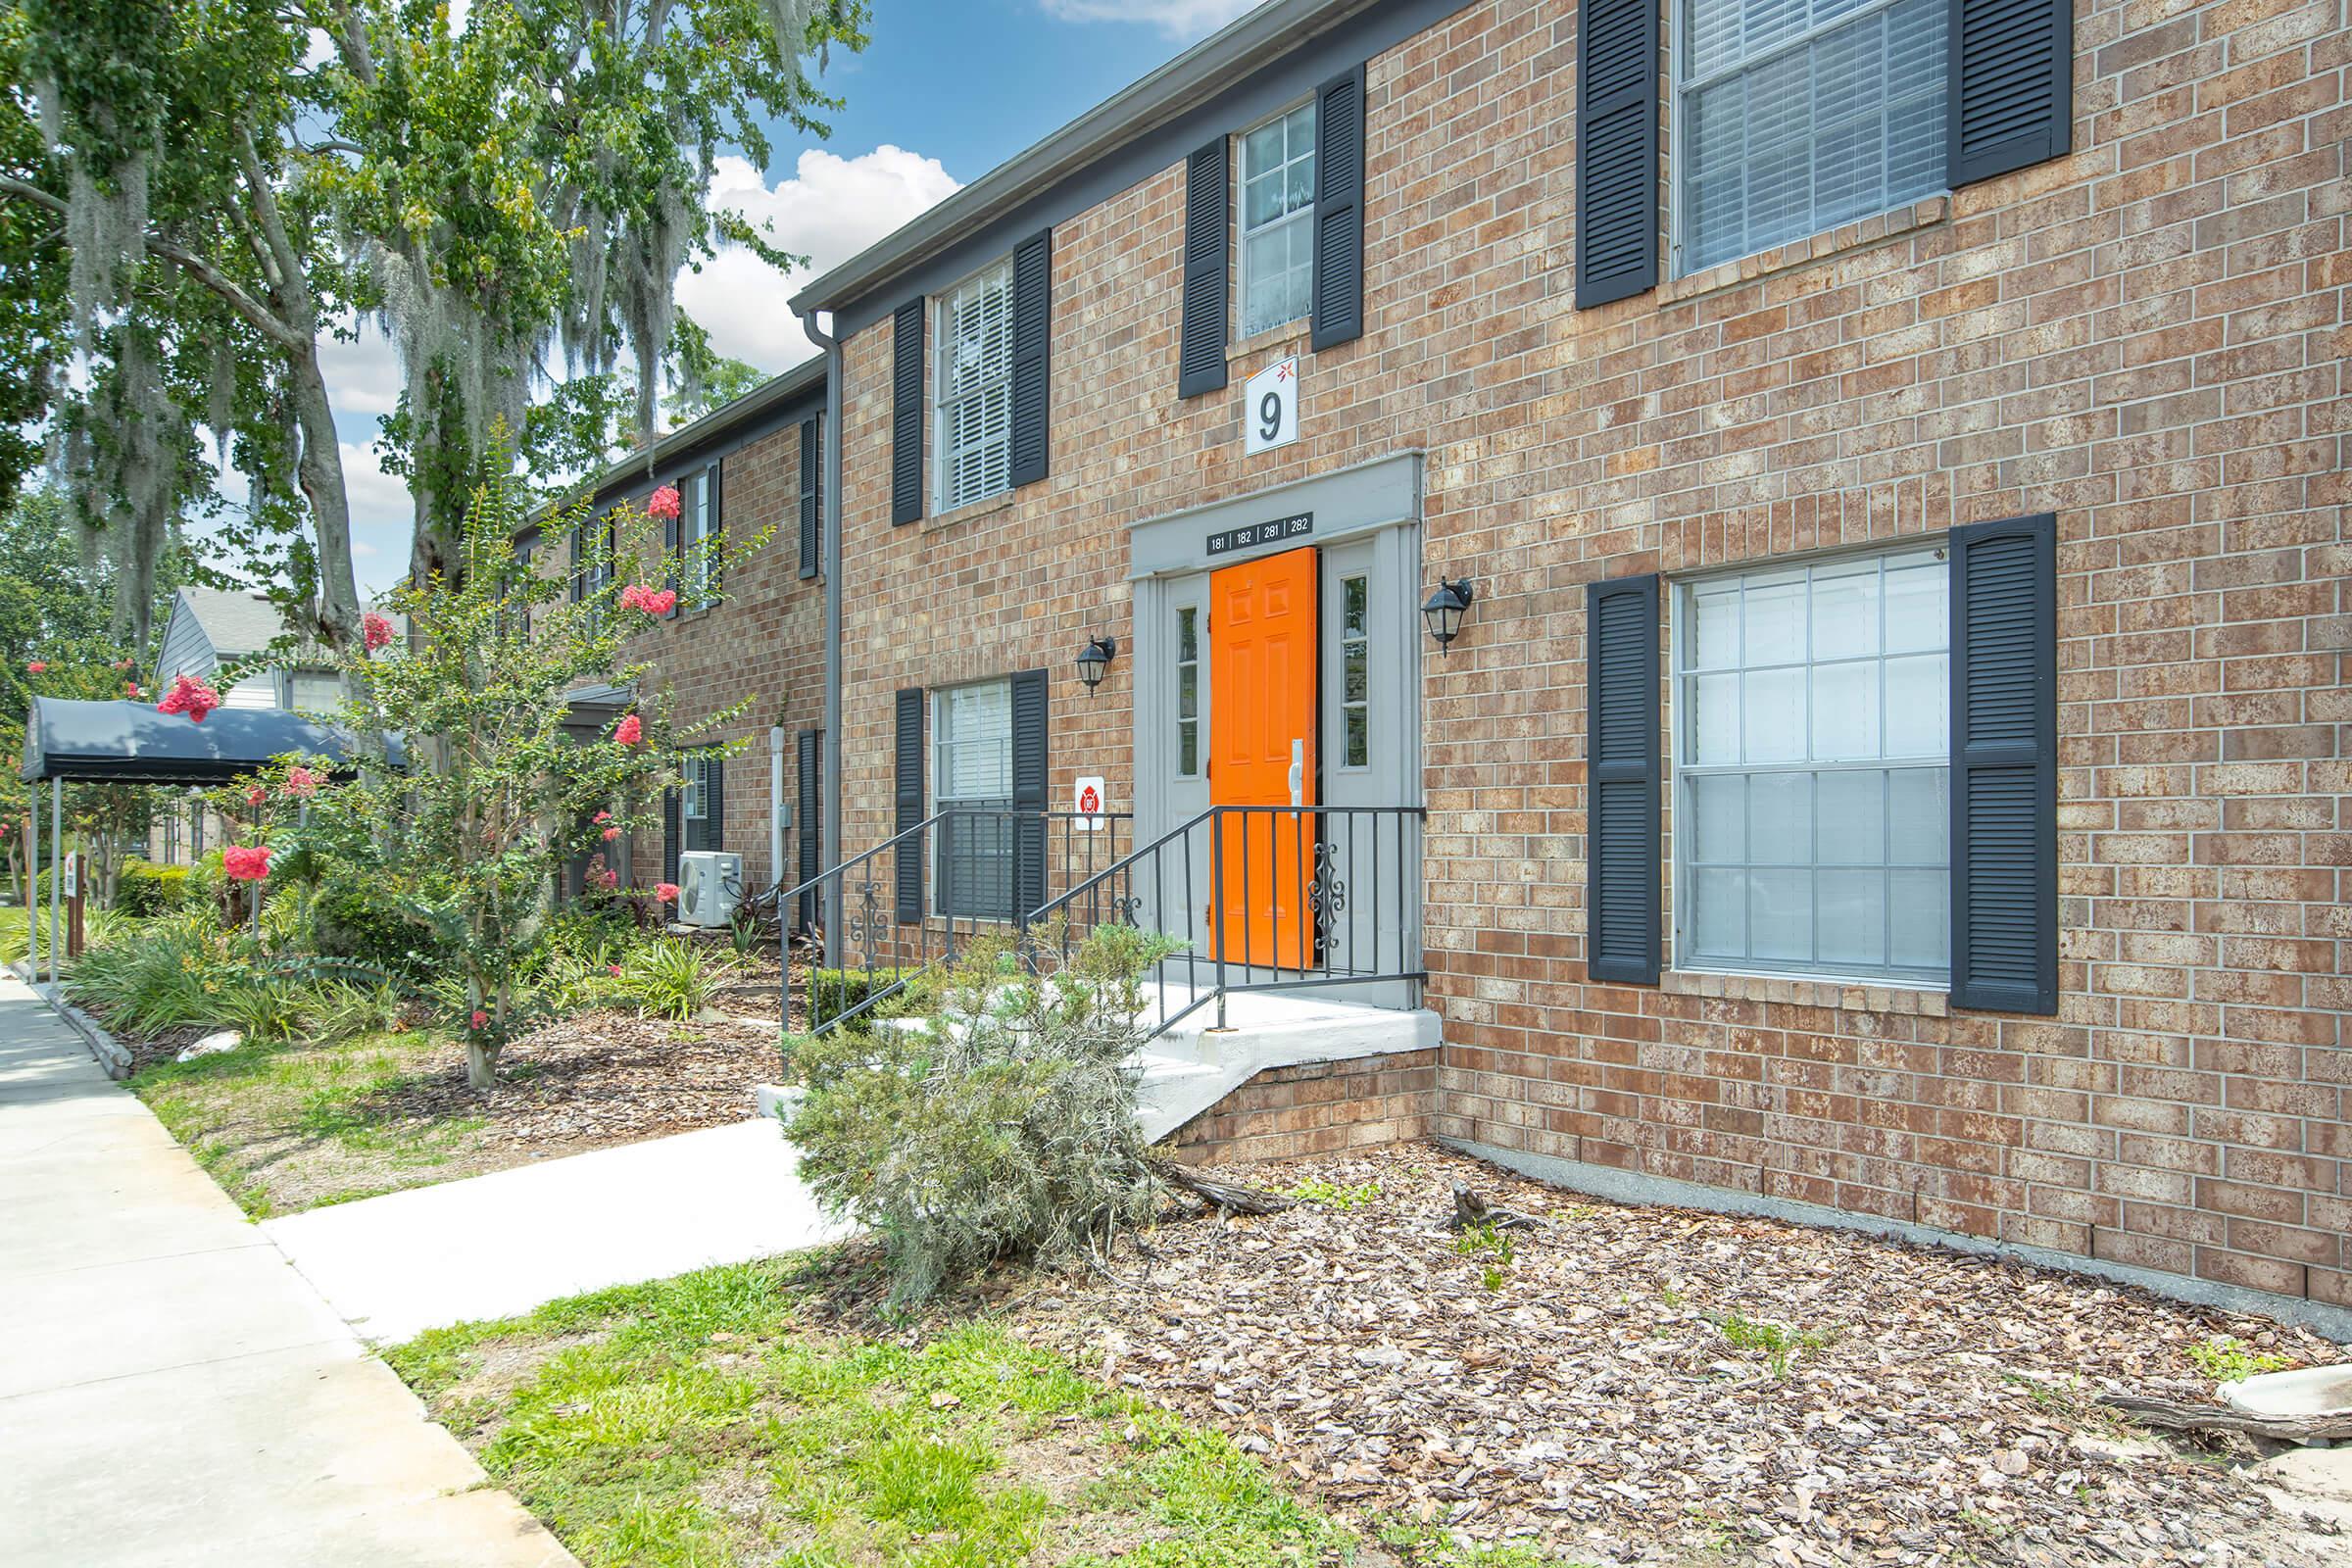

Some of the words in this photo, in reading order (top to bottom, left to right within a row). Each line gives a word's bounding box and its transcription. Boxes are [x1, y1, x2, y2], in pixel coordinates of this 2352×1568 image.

[1260, 392, 1281, 441] 9
[1211, 537, 1224, 550] 181
[1237, 531, 1251, 545] 182
[1264, 524, 1279, 539] 281
[1291, 517, 1308, 532] 282
